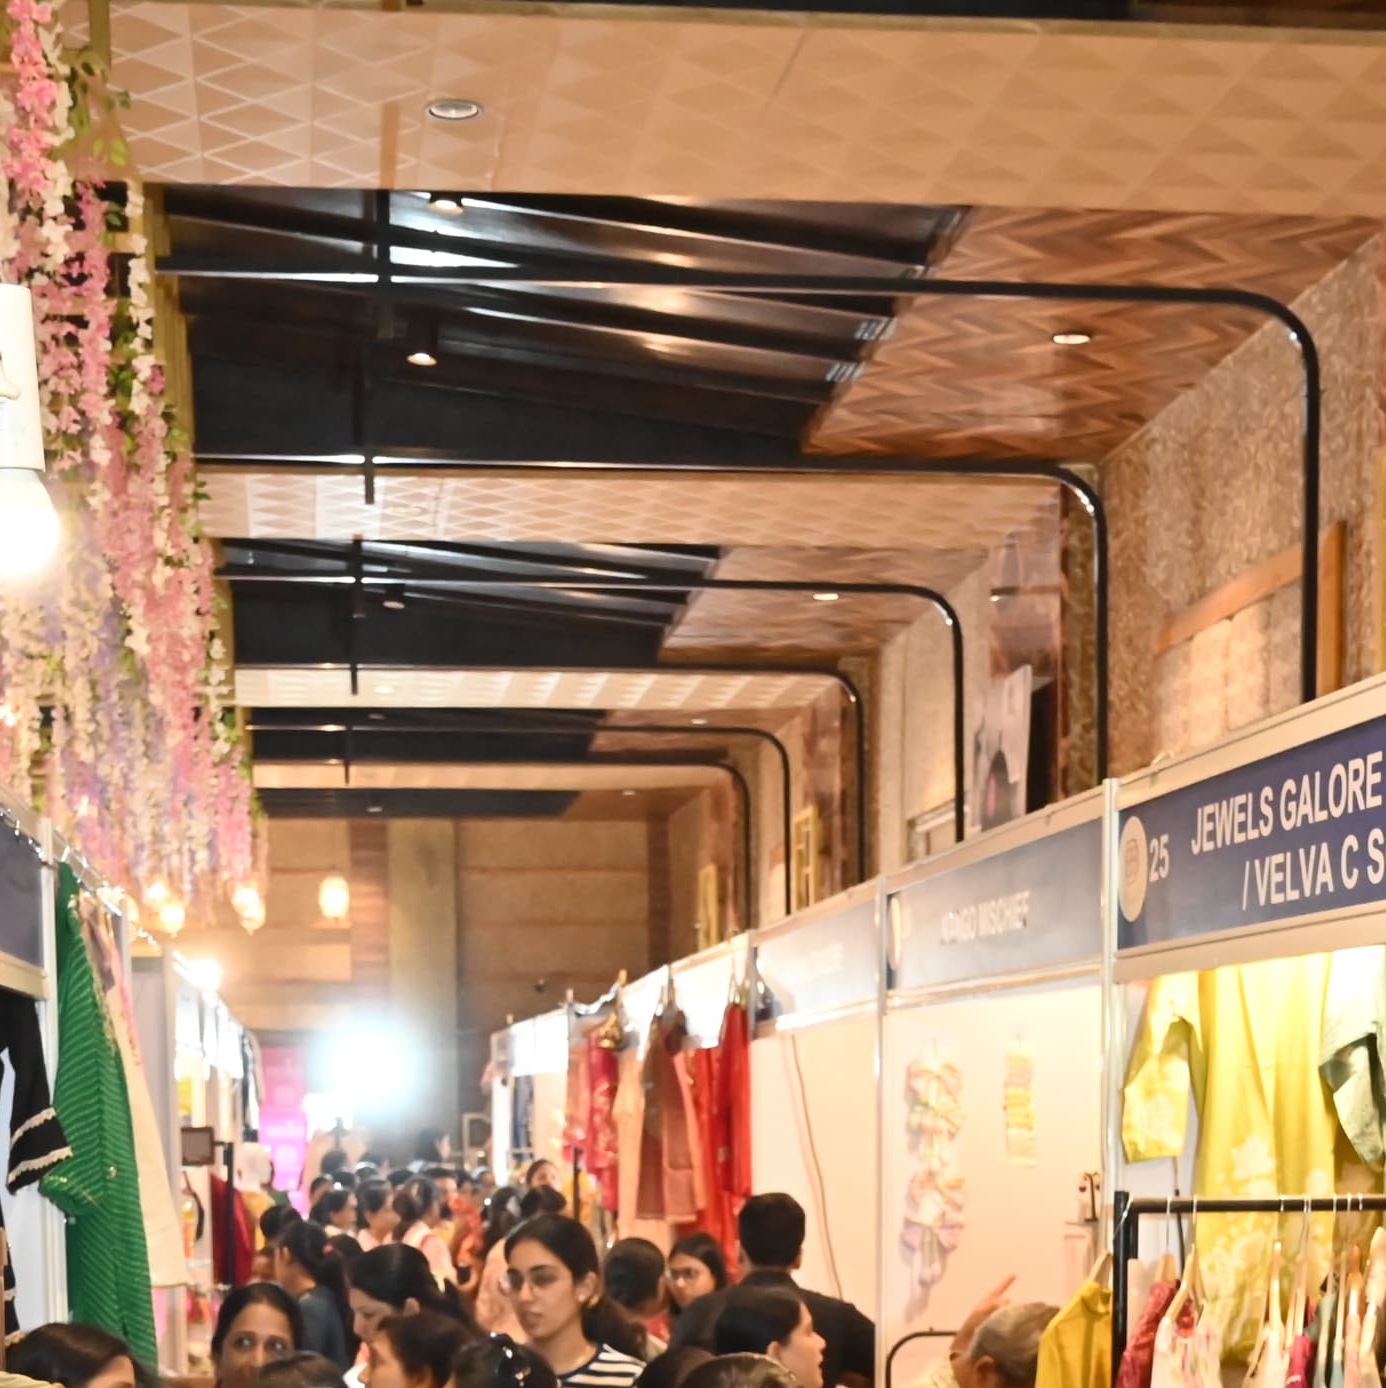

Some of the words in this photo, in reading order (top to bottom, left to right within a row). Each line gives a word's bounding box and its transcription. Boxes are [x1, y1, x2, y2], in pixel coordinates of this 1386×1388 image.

[1190, 785, 1274, 857] JEWELS
[1279, 750, 1383, 831] GALORE
[1149, 833, 1170, 883] 25
[1255, 841, 1334, 908] VELVA
[1340, 834, 1359, 890] C
